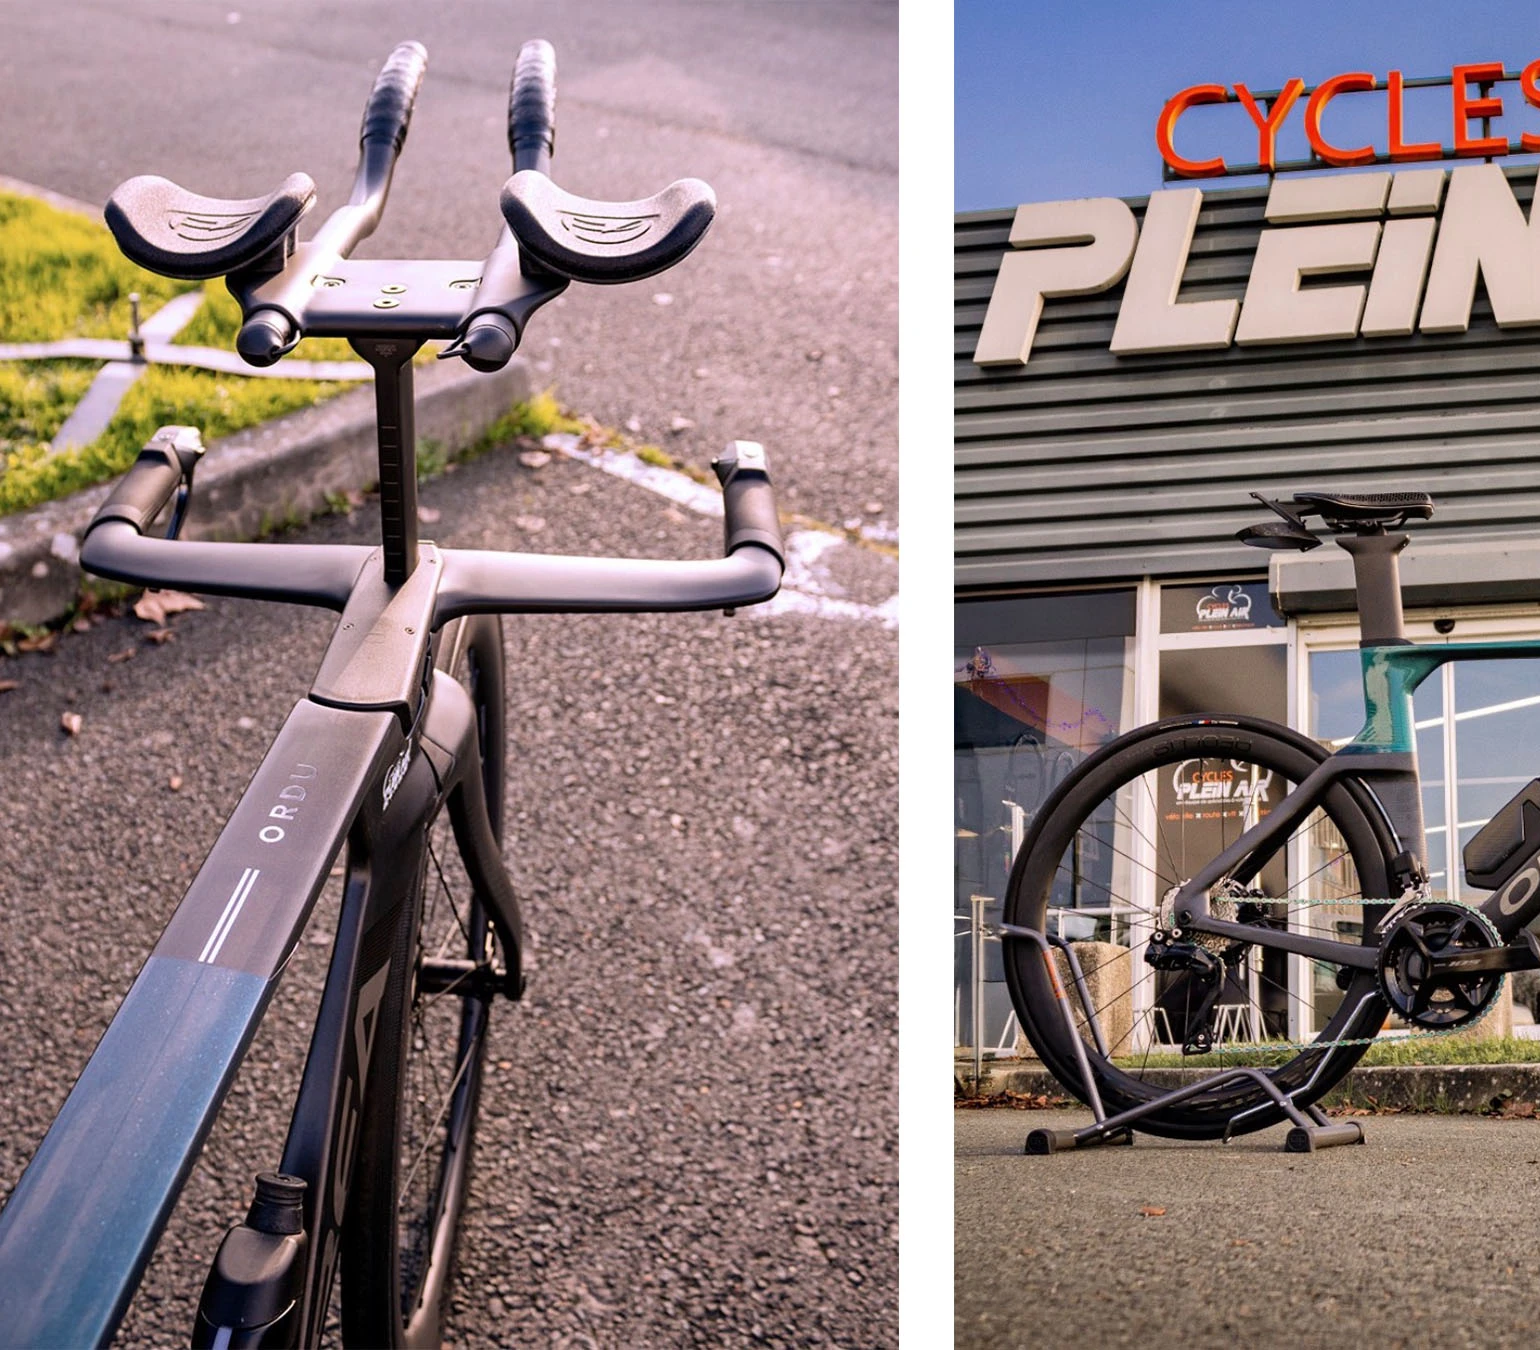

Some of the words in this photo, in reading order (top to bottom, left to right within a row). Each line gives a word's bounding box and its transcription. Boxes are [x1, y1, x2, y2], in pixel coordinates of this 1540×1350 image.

[1192, 771, 1234, 783] CYCLES
[1177, 781, 1232, 800] PLEIN
[259, 763, 318, 843] ORDU
